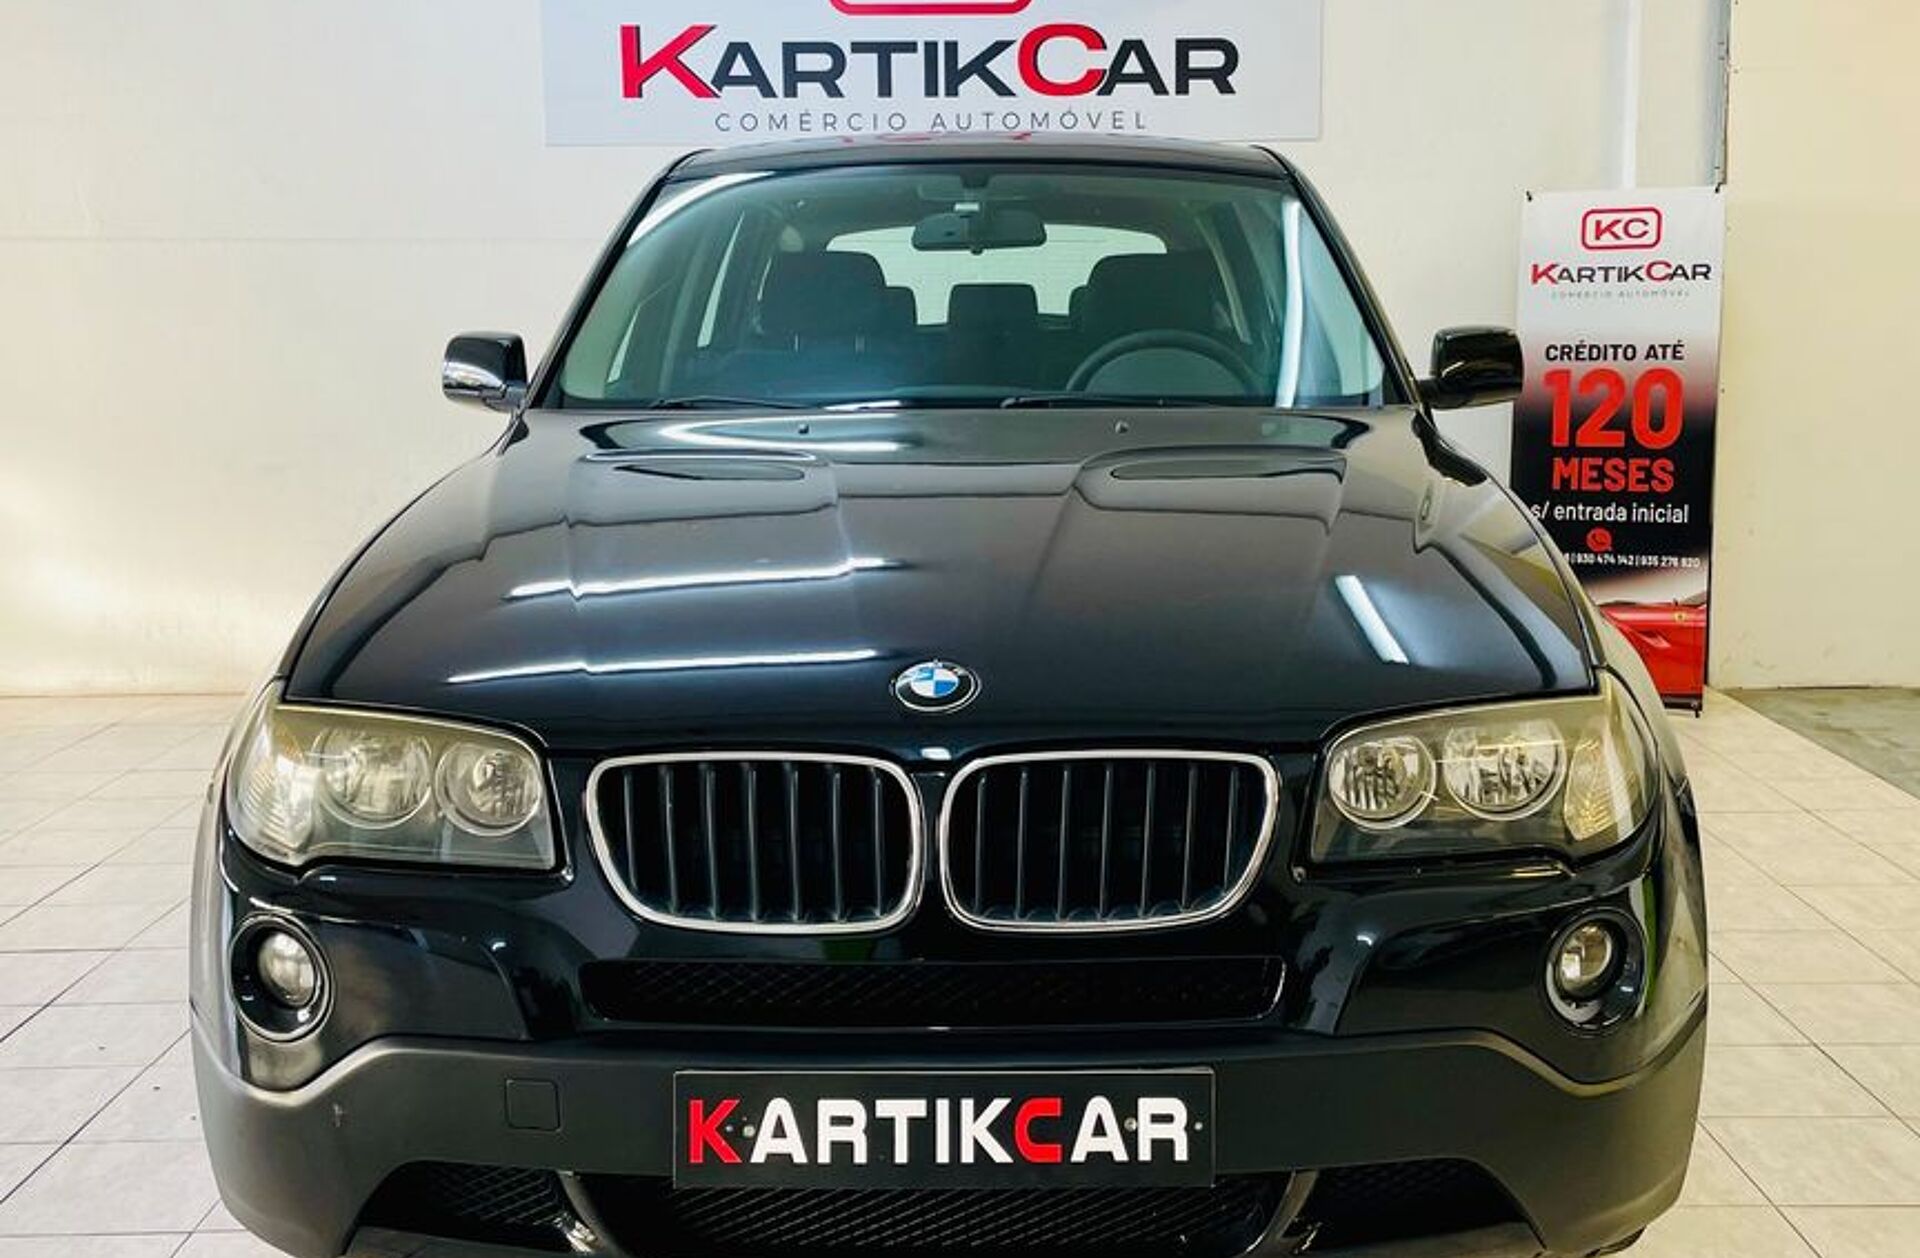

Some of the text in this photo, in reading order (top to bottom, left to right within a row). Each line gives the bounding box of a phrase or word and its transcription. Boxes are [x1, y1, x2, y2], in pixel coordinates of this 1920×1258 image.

[714, 106, 1148, 132] COMÉRCIO AUTOMÓVEL
[1594, 217, 1651, 241] KC
[1545, 339, 1685, 361] CRÉDITO ATÉ
[1543, 367, 1685, 449] 120
[1552, 456, 1675, 493] MESES
[1553, 502, 1628, 521] entrada
[1632, 502, 1690, 524] inicial
[689, 1096, 1189, 1164] KARTIKCAR
